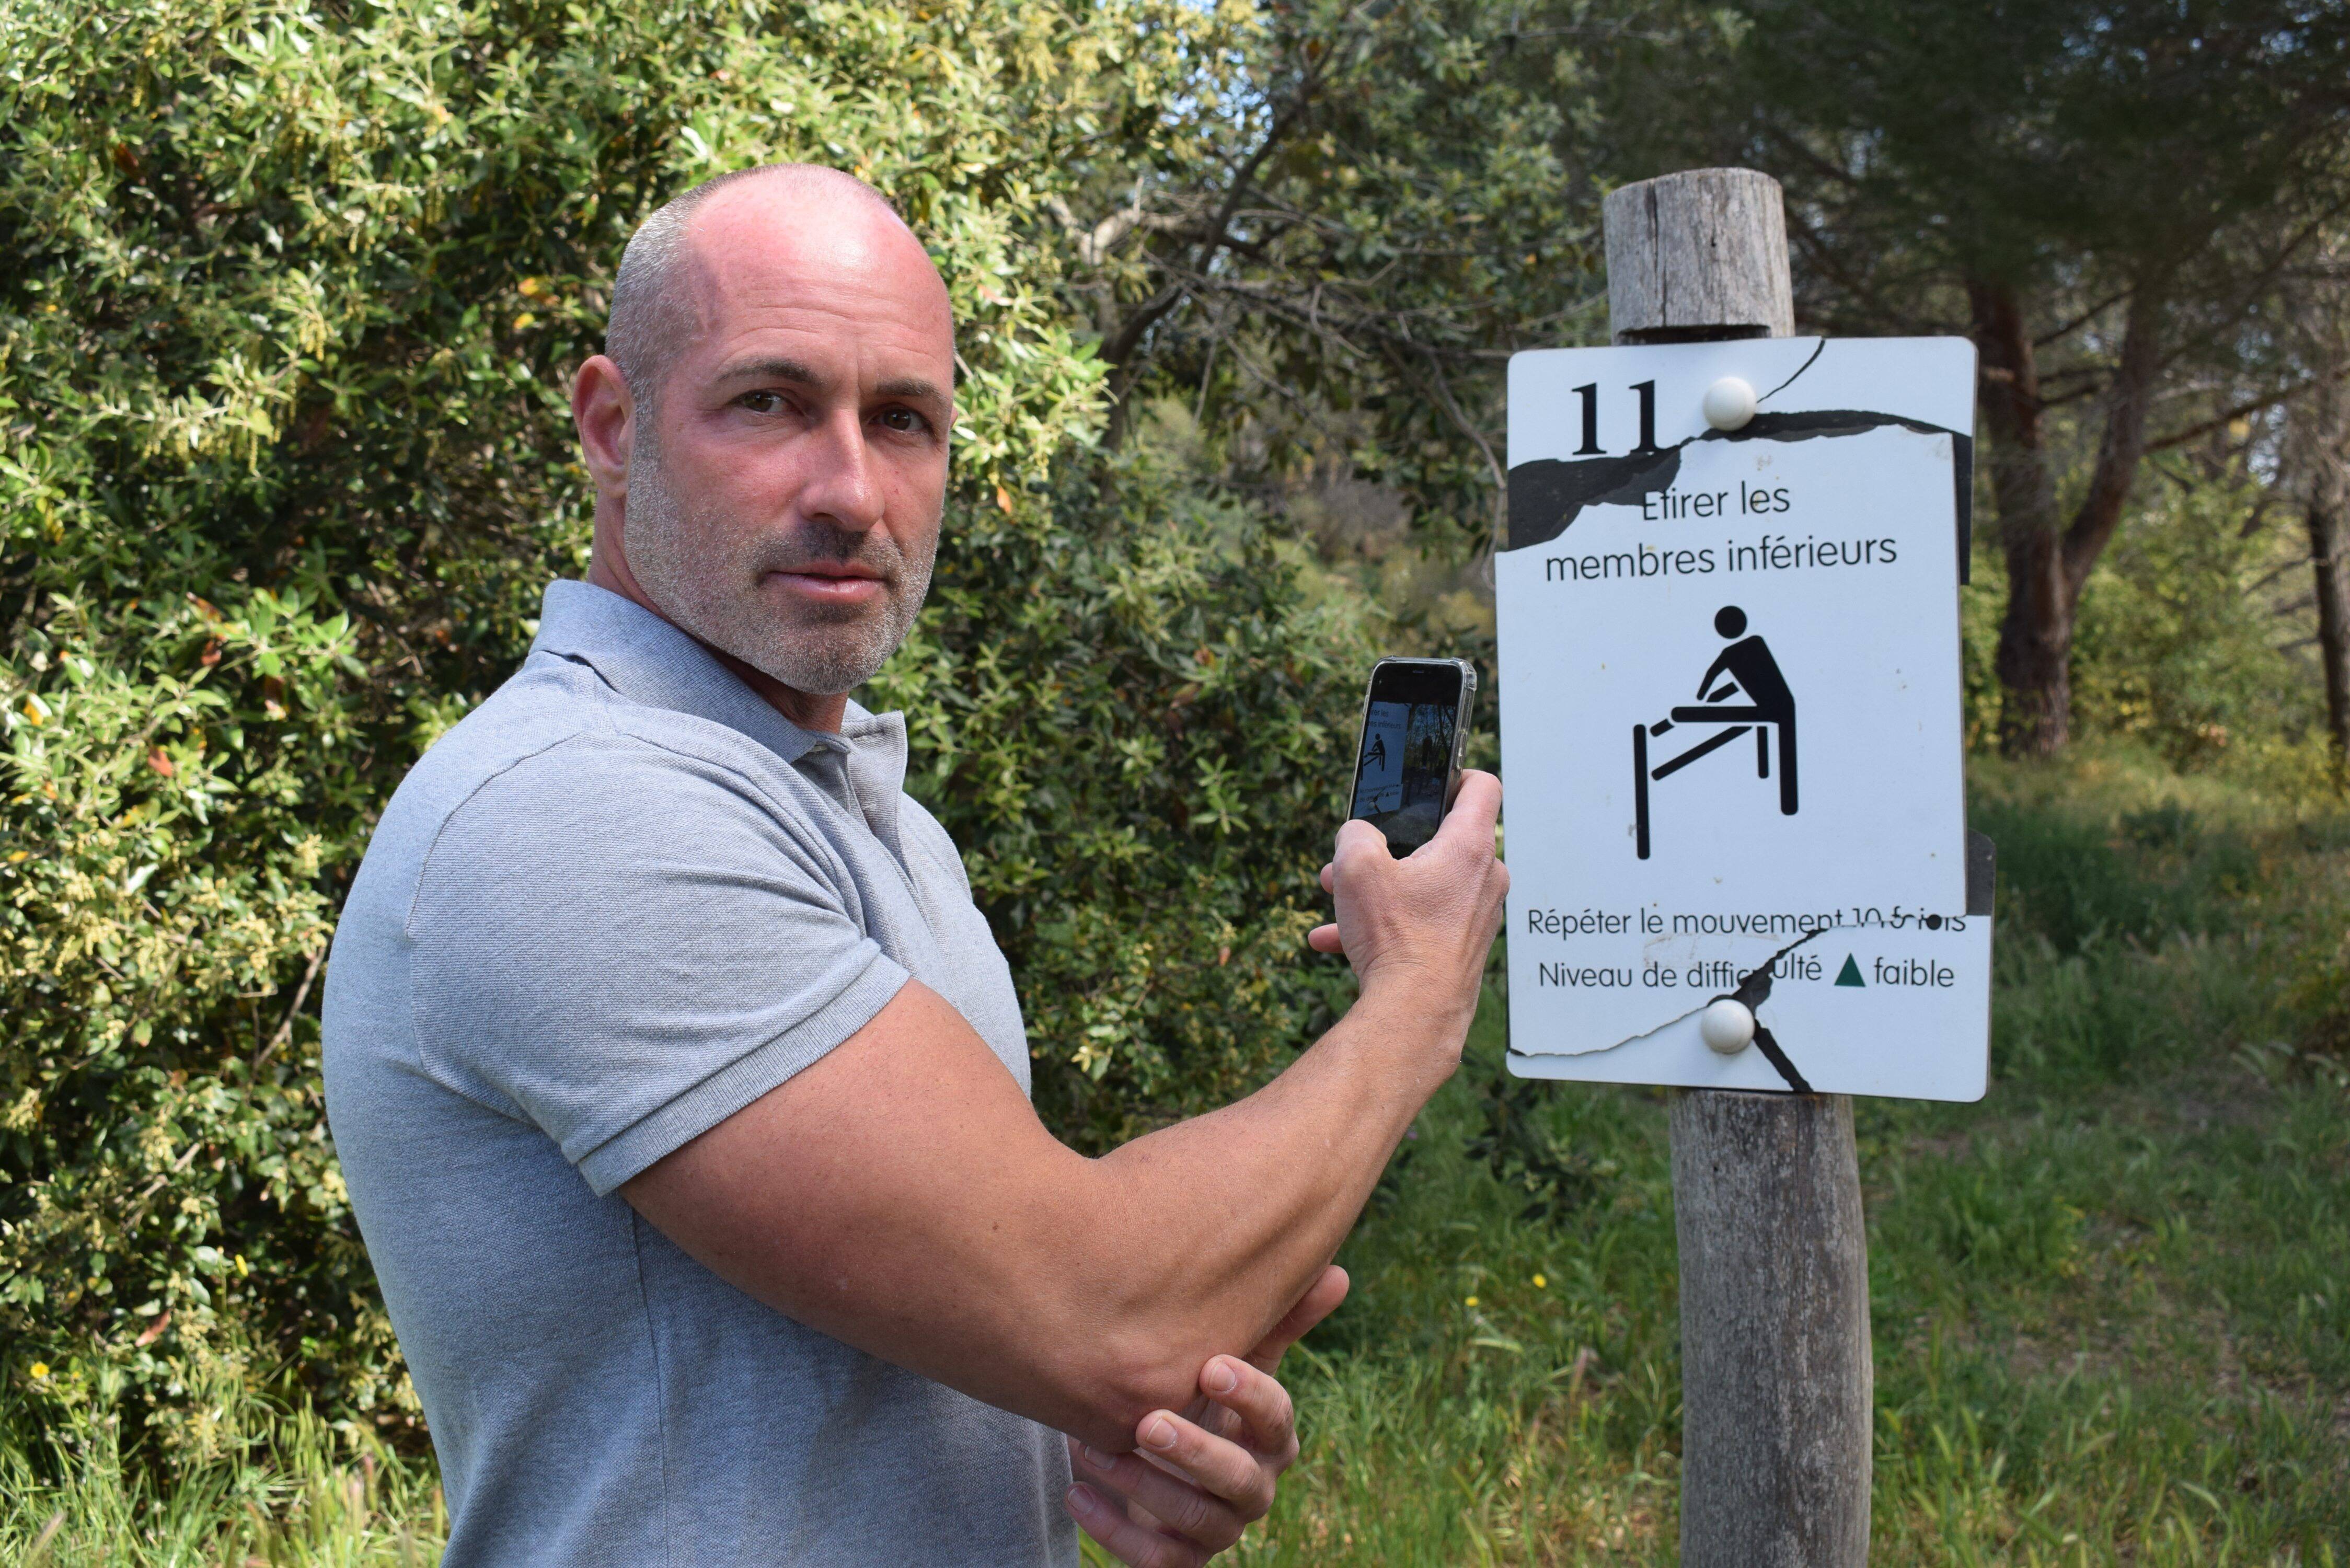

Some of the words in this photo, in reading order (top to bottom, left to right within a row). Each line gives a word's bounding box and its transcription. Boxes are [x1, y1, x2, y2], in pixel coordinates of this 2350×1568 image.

[1572, 379, 1666, 456] 11
[1741, 480, 1790, 515] les
[1546, 543, 1715, 582] membres
[1727, 535, 1897, 571] inférieurs
[1528, 908, 1631, 940] Répéter
[1641, 907, 1663, 933] le
[1674, 908, 1842, 934] mouvement
[1540, 962, 1632, 987] Niveau
[1643, 961, 1677, 987] de
[1874, 957, 1954, 987] faible
